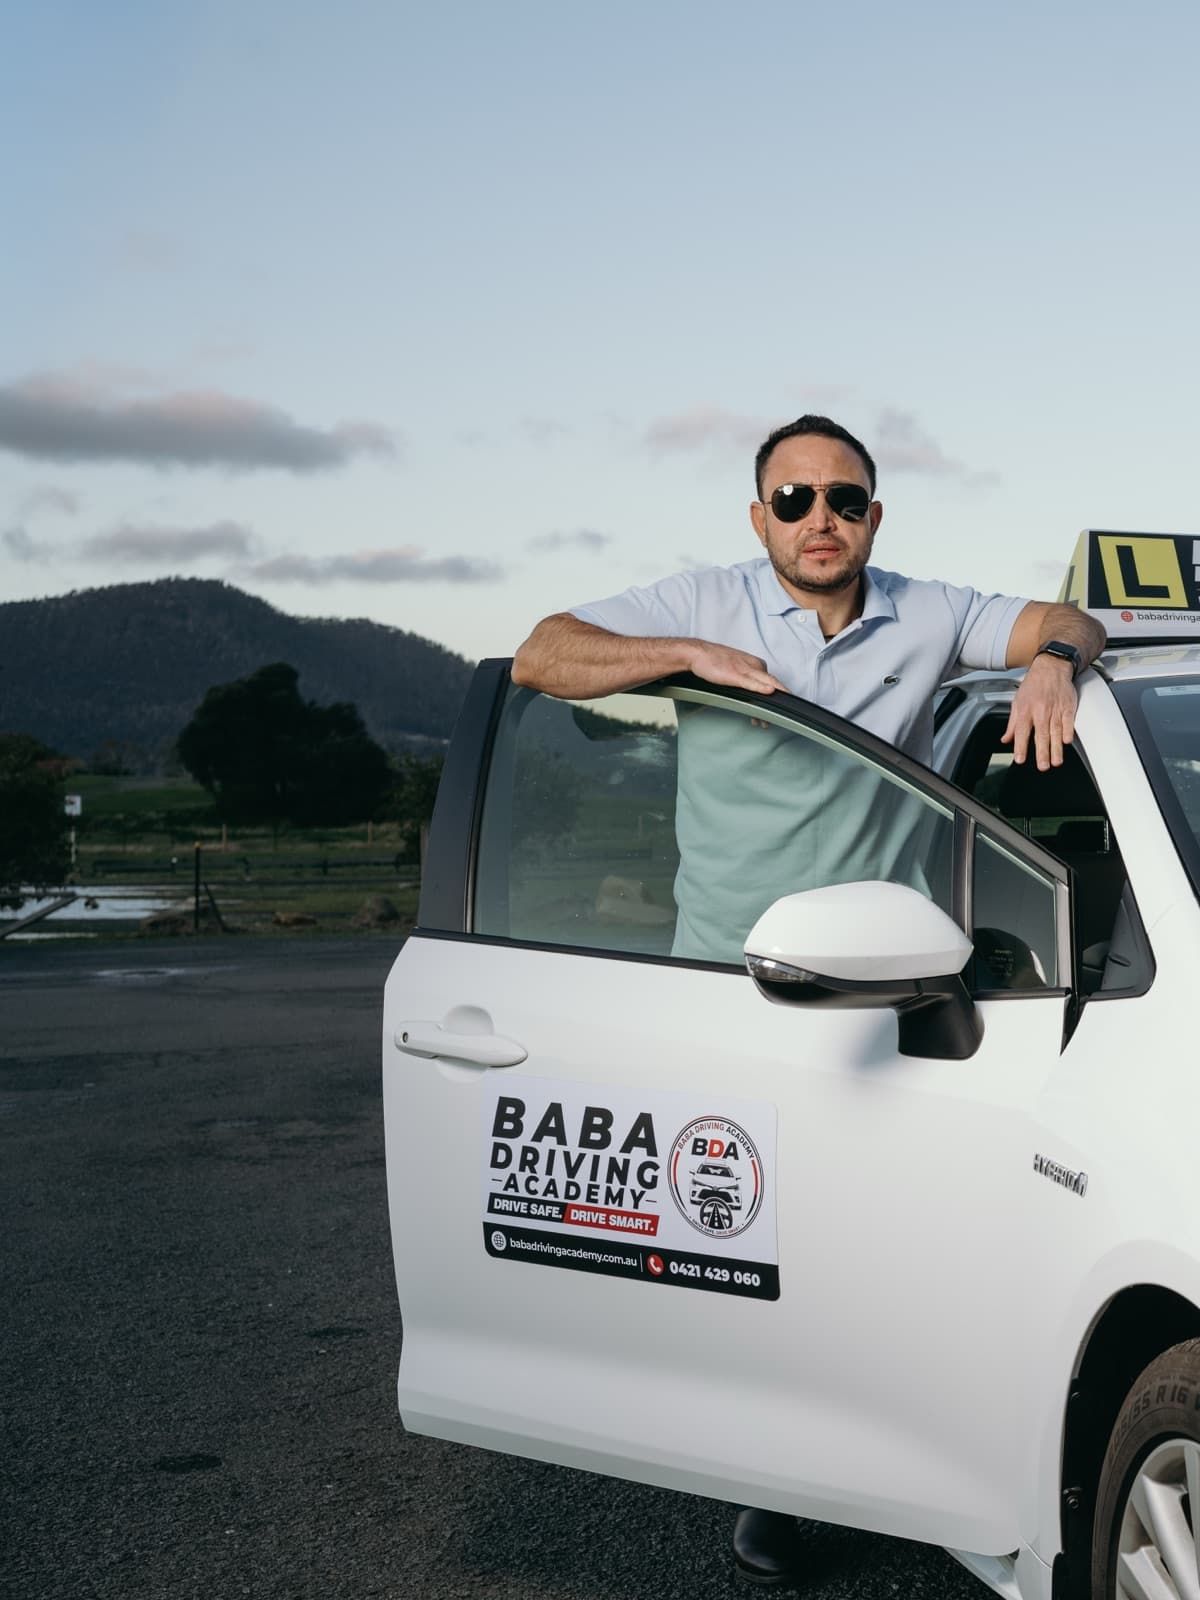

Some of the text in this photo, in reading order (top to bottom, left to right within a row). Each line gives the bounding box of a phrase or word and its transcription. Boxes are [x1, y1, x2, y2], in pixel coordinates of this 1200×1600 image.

[1115, 544, 1171, 598] L
[492, 1096, 658, 1157] BABA
[678, 1121, 755, 1159] BABA DRIVING ACADEMY
[490, 1141, 660, 1190] DRIVING
[691, 1137, 739, 1160] BDA
[503, 1173, 646, 1209] ACADEMY
[493, 1197, 655, 1231] DRIVE SAFE. DRIVE SMART.
[510, 1237, 637, 1267] babadrivingacademy.com.au
[669, 1261, 761, 1287] 0421 429 060
[1156, 1384, 1168, 1404] R
